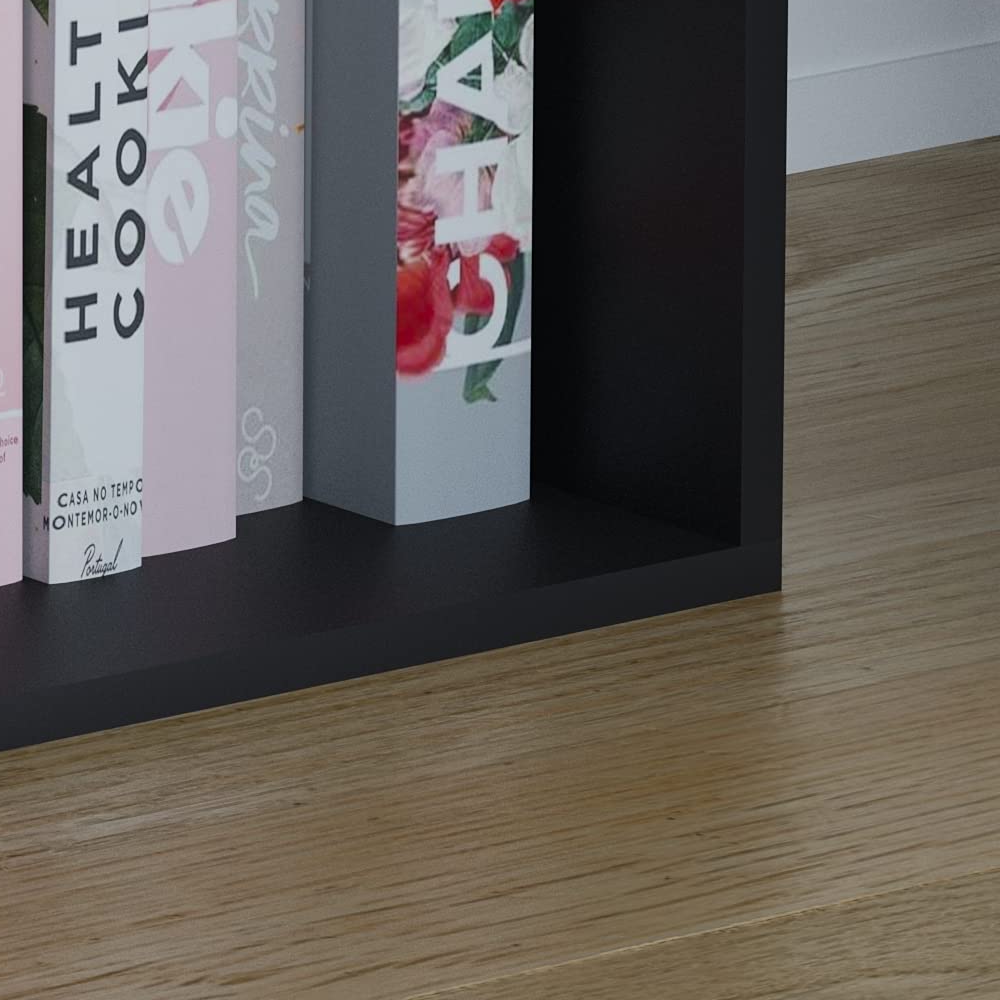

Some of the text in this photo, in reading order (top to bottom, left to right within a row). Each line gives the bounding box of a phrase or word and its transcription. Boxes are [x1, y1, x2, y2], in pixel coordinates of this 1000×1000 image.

[58, 478, 142, 507] CASA NO TEMPO
[81, 538, 123, 579] Portugal
